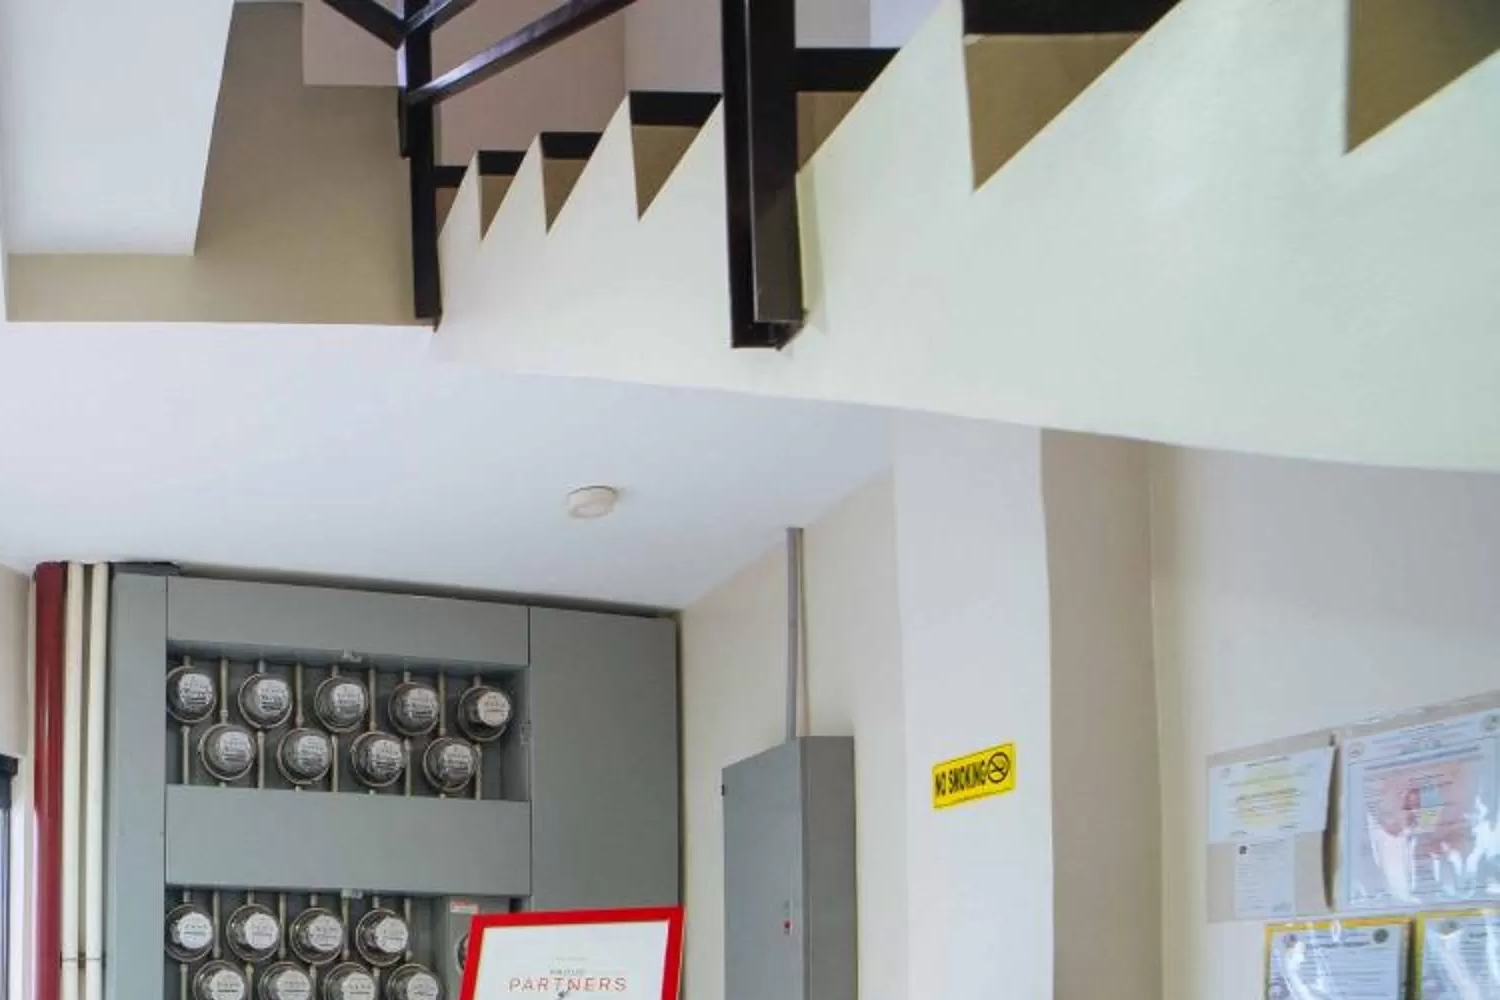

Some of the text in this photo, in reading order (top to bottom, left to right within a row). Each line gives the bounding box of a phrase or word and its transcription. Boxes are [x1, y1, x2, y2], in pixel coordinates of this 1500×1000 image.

[935, 760, 986, 796] NO SMOKING
[508, 977, 628, 992] PARTNERS
